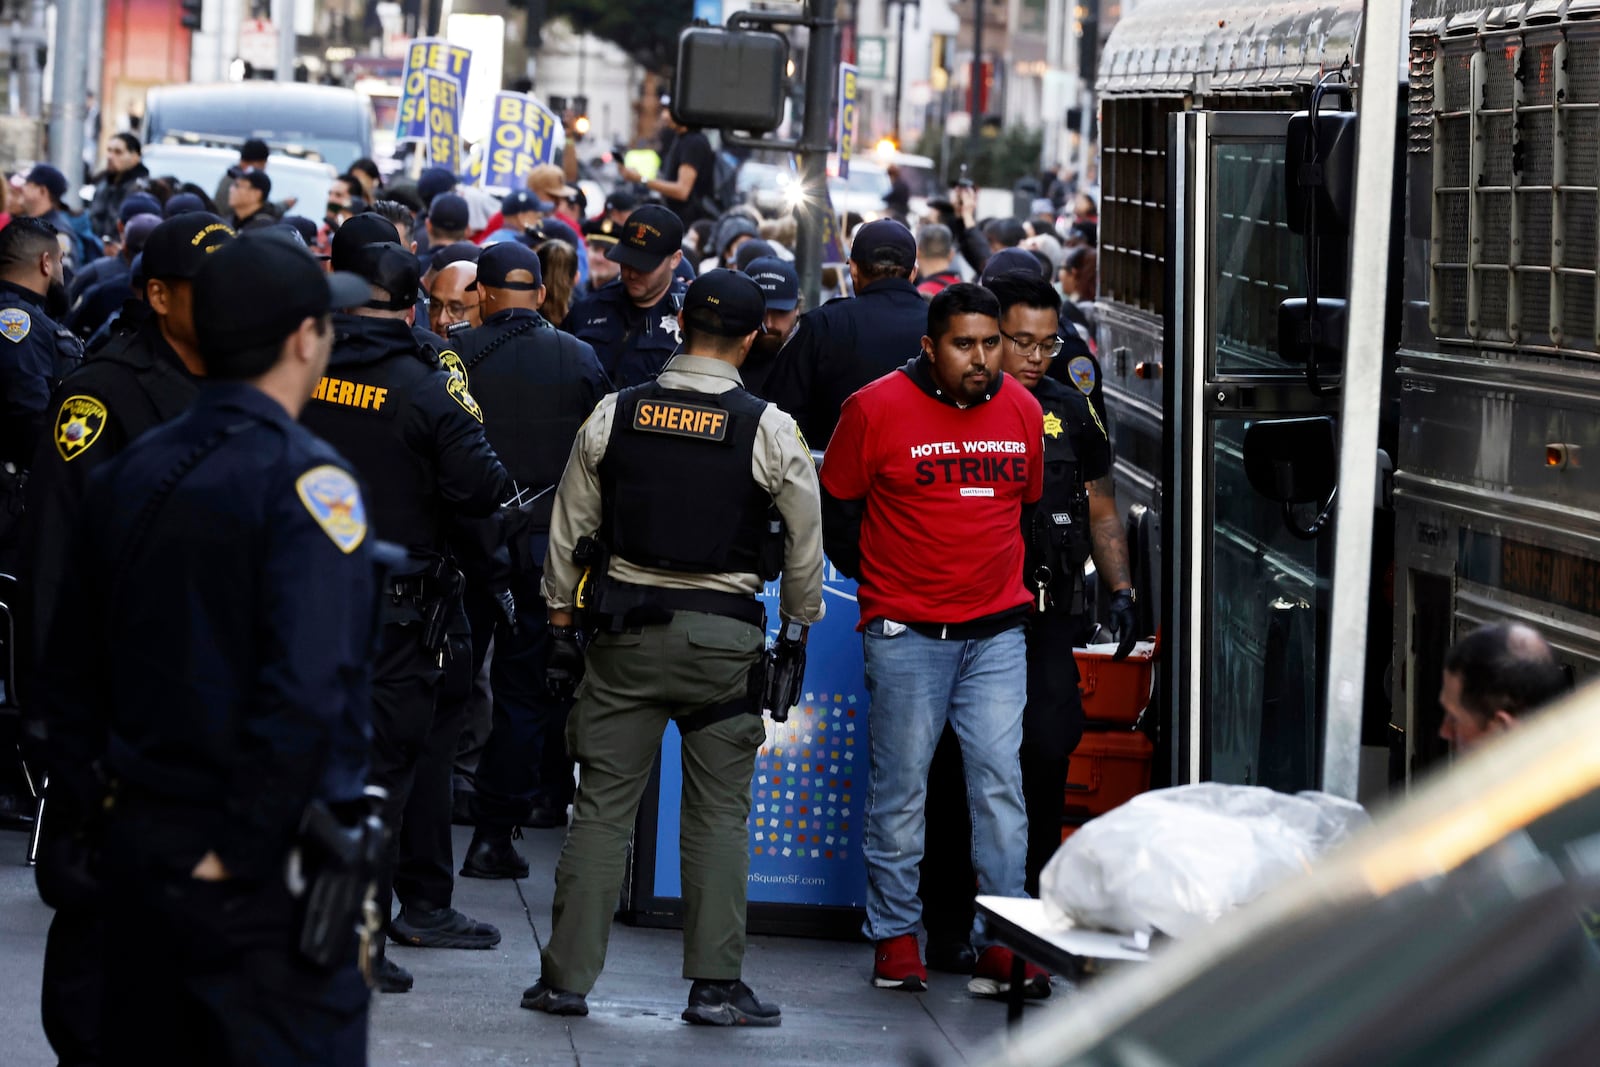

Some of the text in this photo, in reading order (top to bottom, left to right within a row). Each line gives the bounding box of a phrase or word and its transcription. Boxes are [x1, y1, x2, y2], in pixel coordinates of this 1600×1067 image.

[410, 44, 469, 74] BET
[407, 71, 425, 96] O
[430, 77, 456, 109] BET
[499, 97, 553, 139] BET
[496, 123, 543, 160] ON
[492, 147, 534, 177] SF
[311, 376, 388, 411] HERIFF
[639, 404, 724, 434] SHERIFF
[911, 441, 1026, 458] HOTEL WORKERS
[915, 458, 1026, 486] STRIKE
[747, 873, 825, 885] nSquareSF.com
